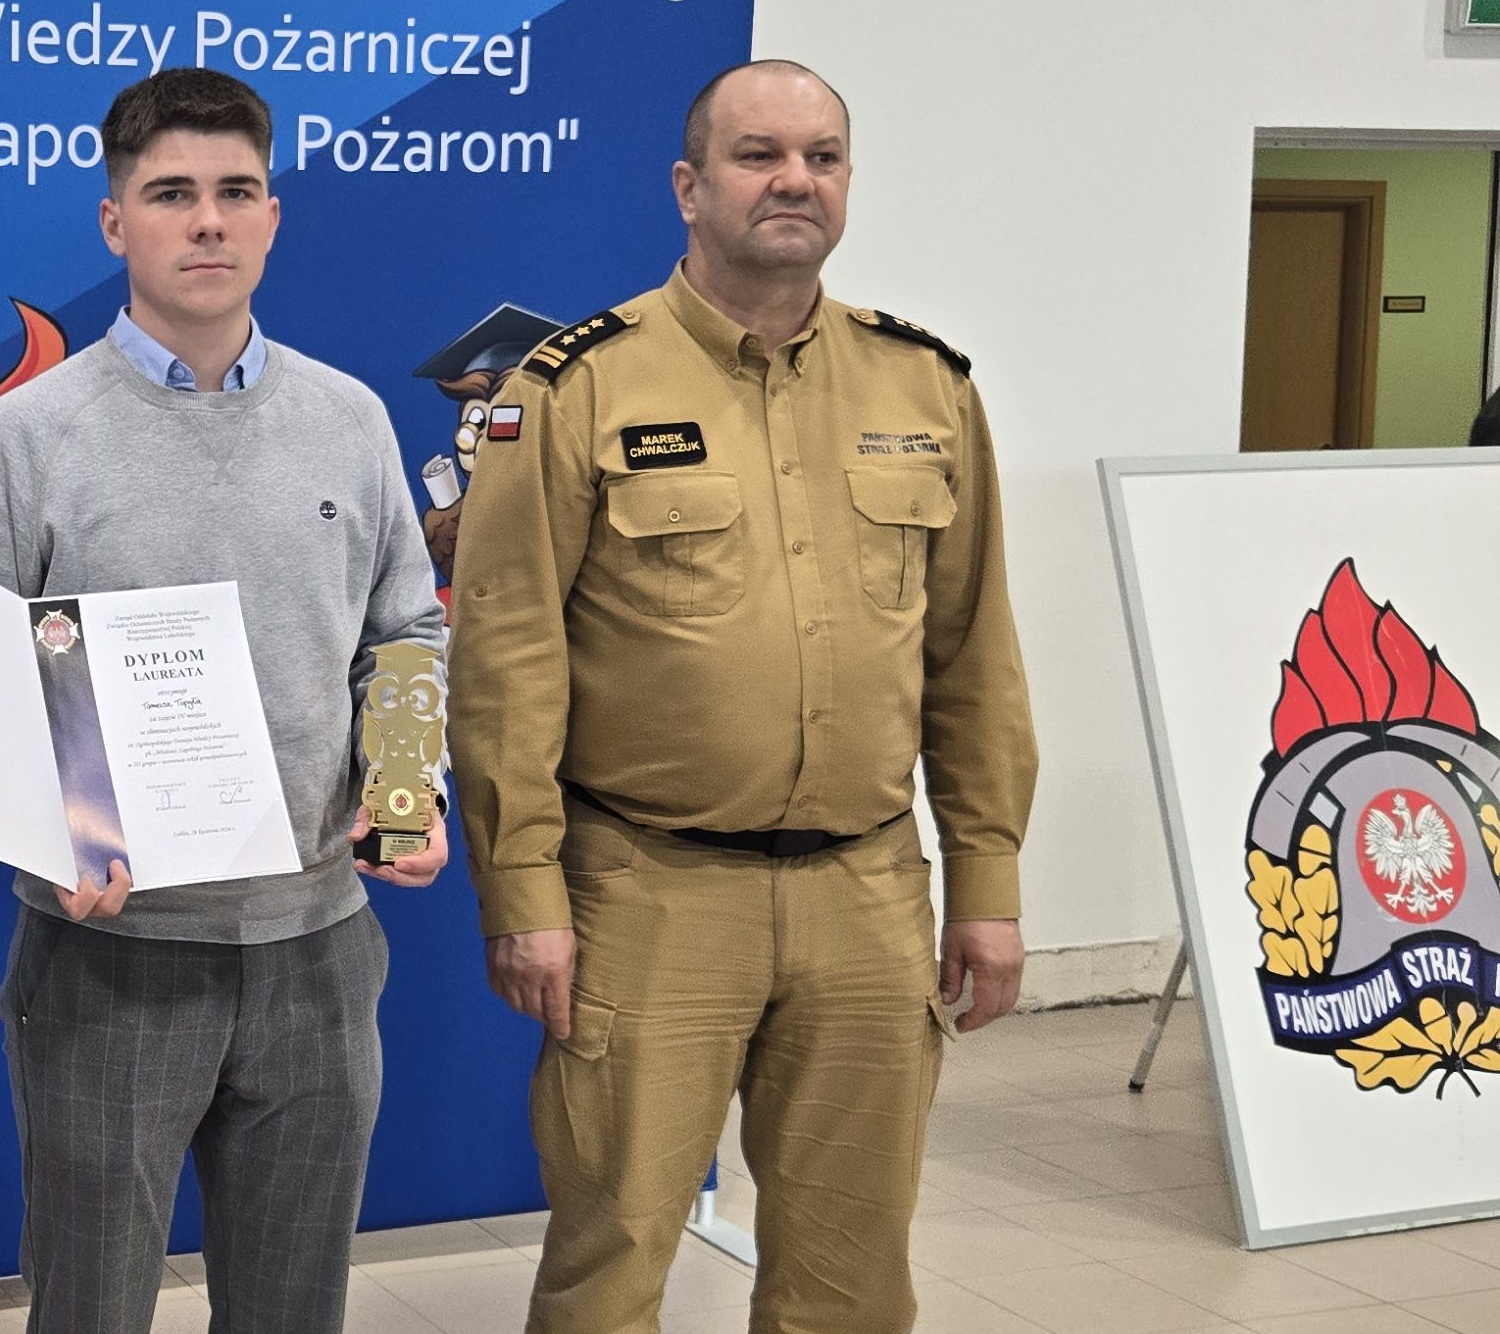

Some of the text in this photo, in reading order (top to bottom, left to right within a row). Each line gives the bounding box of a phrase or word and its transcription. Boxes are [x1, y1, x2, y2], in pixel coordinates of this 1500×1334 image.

[196, 10, 534, 96] Pożarniczej
[297, 115, 579, 174] Pożarom"
[629, 441, 700, 457] CHWALCZUK
[641, 433, 684, 446] MAREK
[124, 648, 205, 668] DYPLOM
[133, 668, 204, 682] LAUREATA
[1274, 968, 1401, 1035] PAŃSTWOWA
[1402, 947, 1474, 989] STRAŻ
